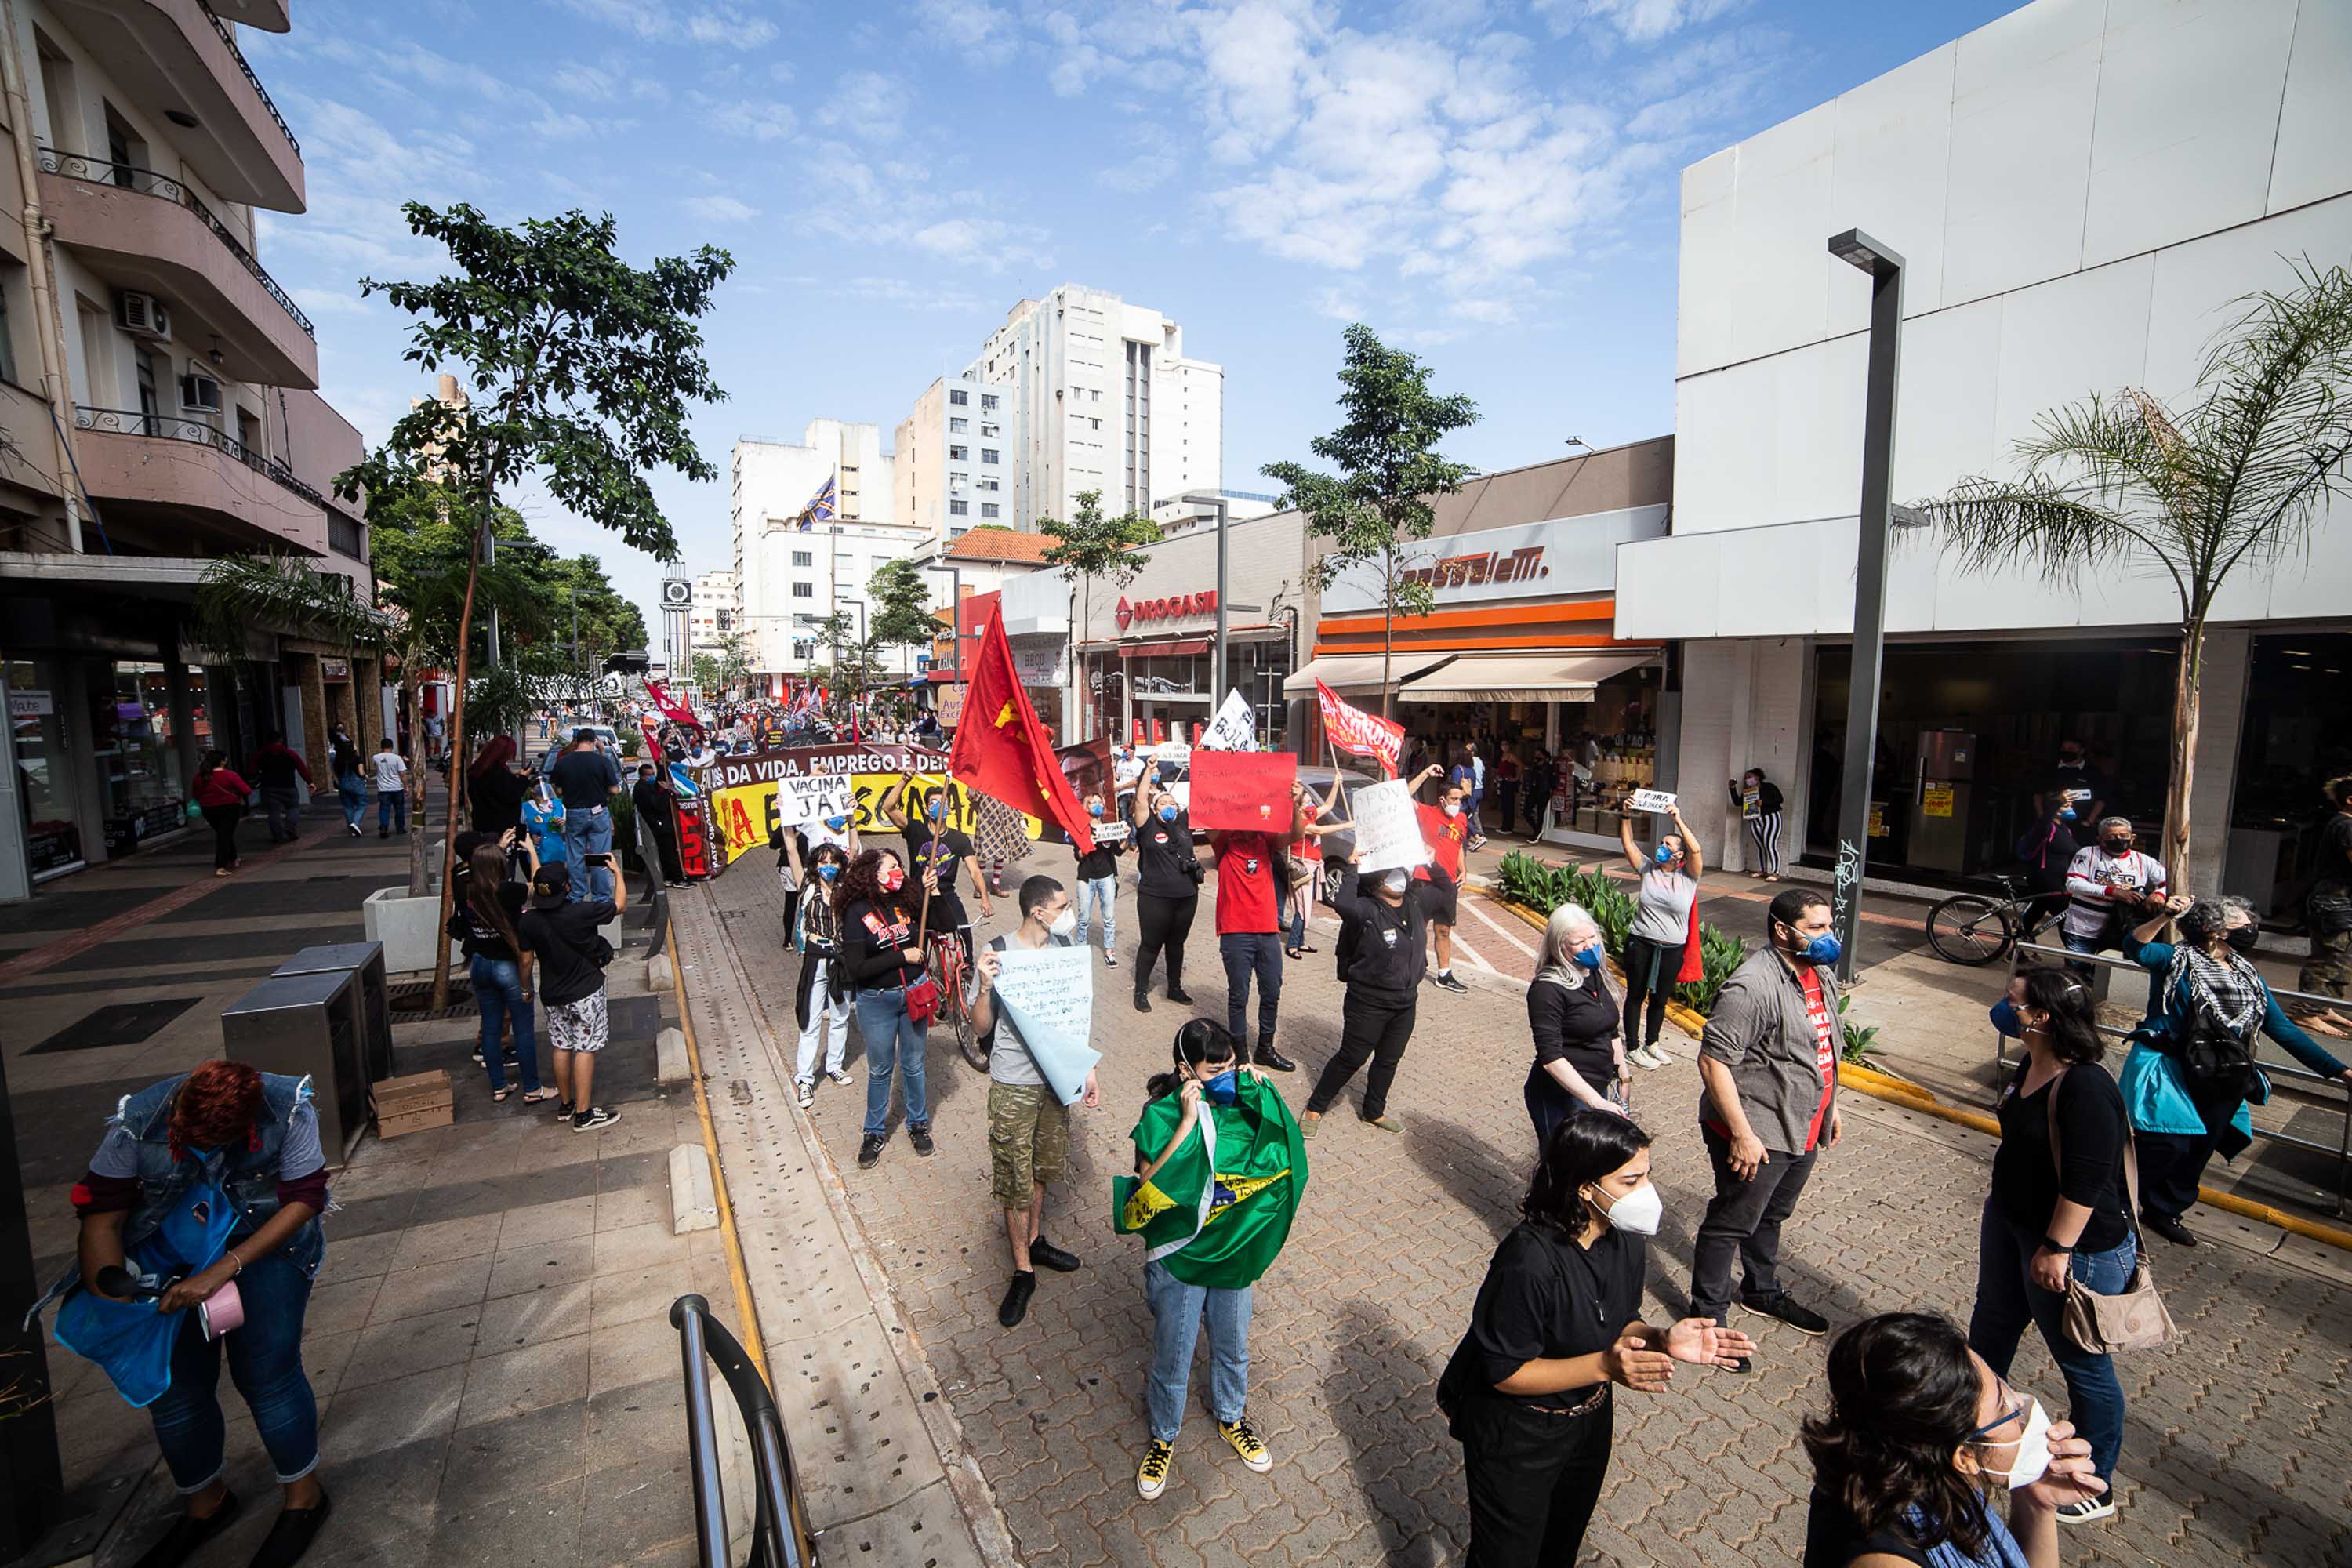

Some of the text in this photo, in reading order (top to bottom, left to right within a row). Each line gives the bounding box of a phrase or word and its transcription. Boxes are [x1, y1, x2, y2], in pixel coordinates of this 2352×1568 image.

[726, 764, 752, 784] DA
[754, 758, 804, 781] VIDA,
[810, 753, 897, 773] EMPREGO
[789, 776, 847, 795] VACINA
[703, 800, 716, 840] GROSSO
[710, 842, 721, 868] MATO
